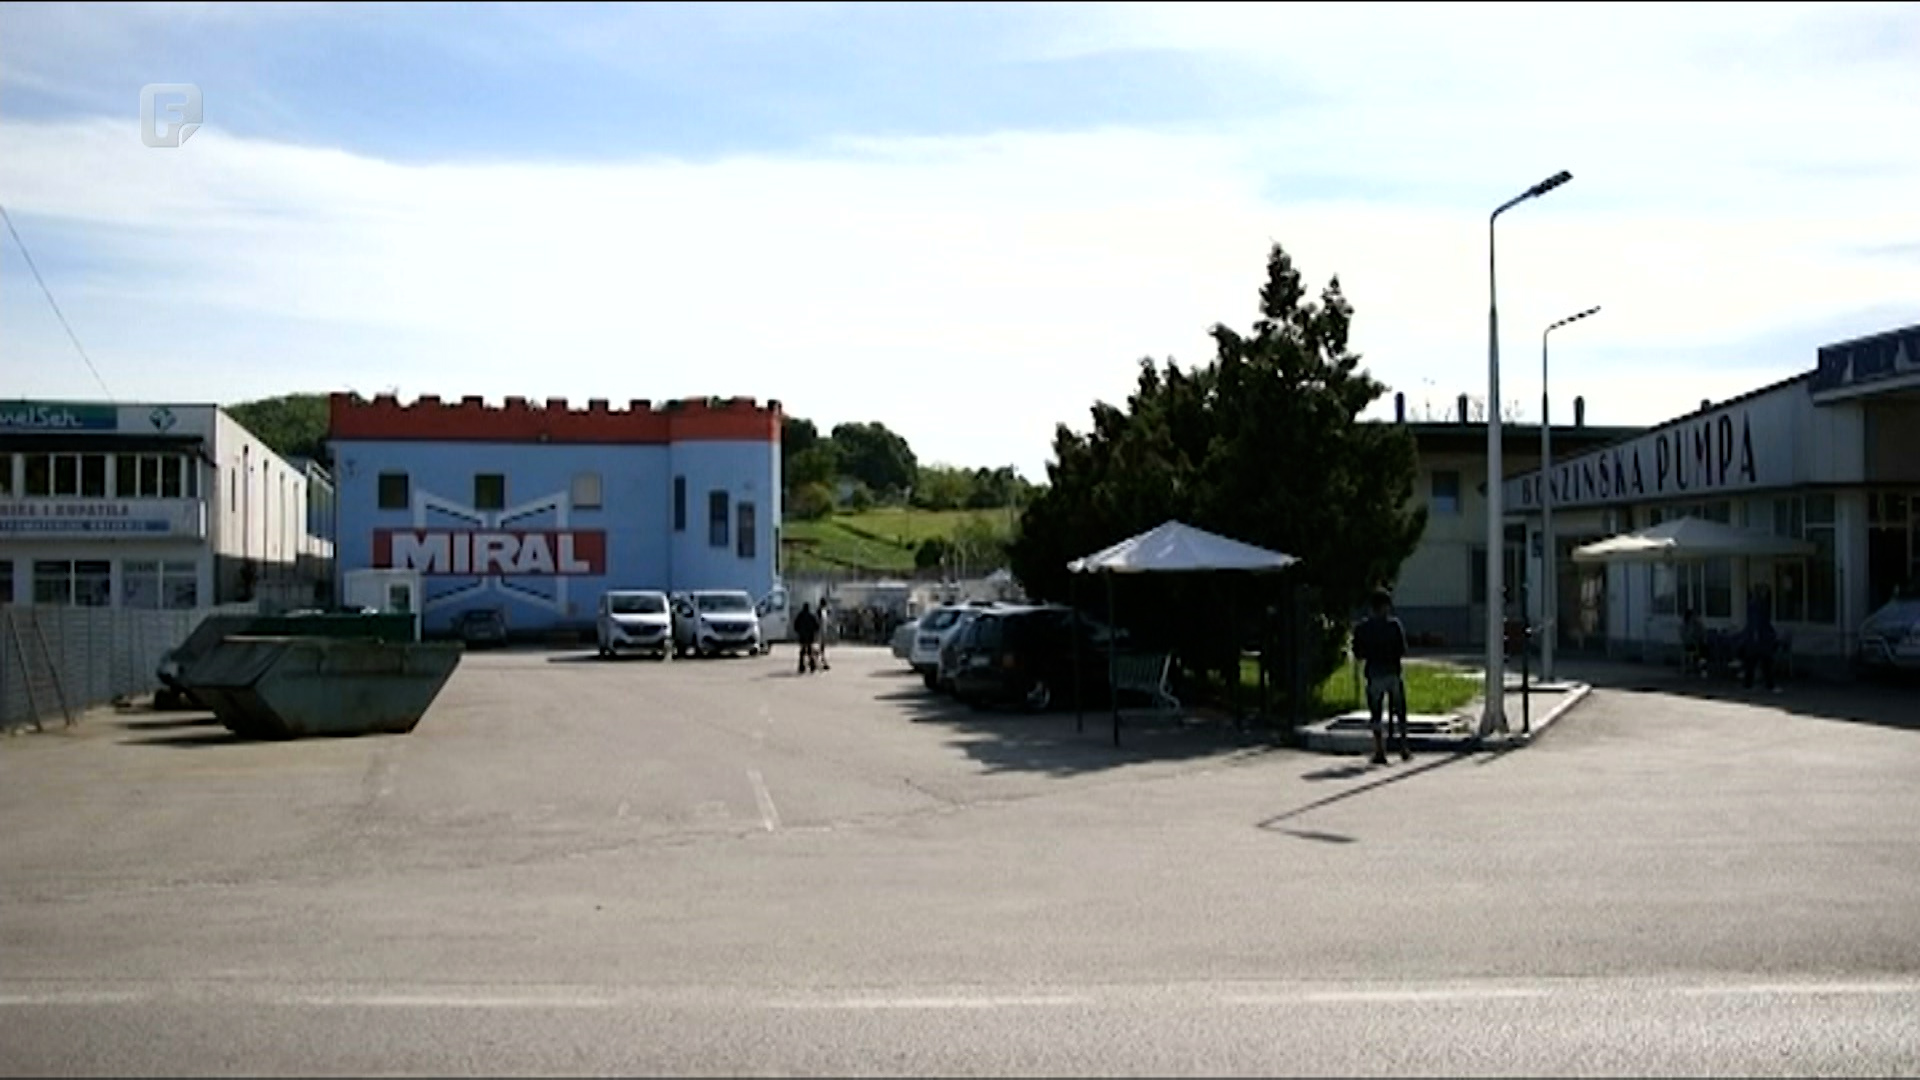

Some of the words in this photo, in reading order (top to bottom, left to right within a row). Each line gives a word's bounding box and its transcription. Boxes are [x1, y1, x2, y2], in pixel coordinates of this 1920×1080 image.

[1522, 446, 1645, 505] BENZINSKA
[1656, 408, 1757, 492] PUMPA
[391, 532, 591, 573] MIRAL
